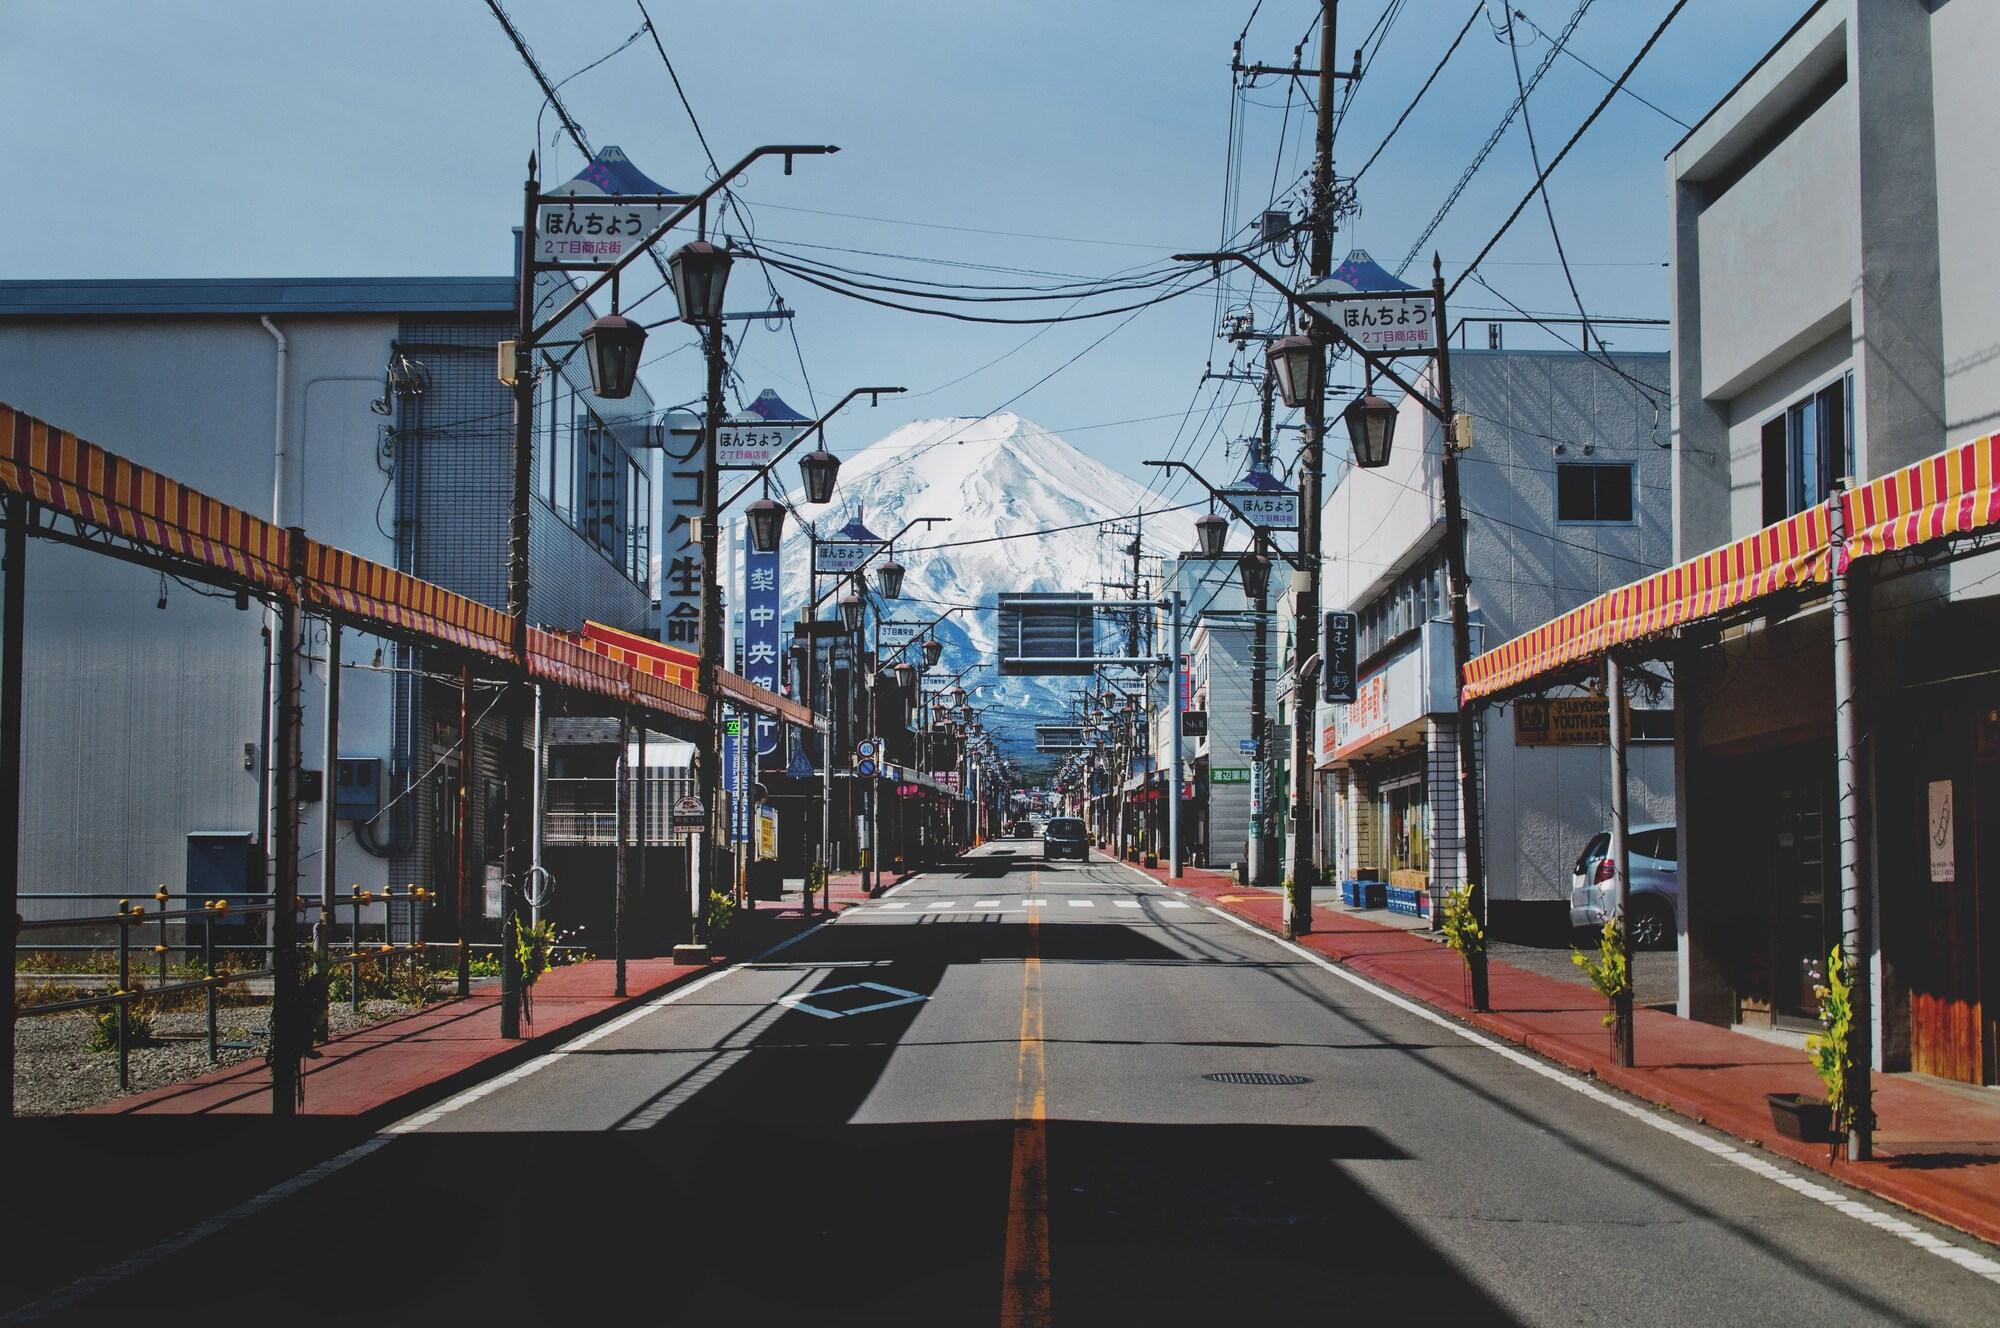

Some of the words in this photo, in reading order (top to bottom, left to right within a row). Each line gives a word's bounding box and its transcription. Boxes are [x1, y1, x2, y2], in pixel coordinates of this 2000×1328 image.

[545, 212, 642, 236] ほんちょう
[1343, 304, 1429, 328] ほんちょう
[720, 431, 783, 448] ほんちょう
[1243, 499, 1295, 514] ほんちょう
[665, 428, 706, 643] フコク生命
[819, 547, 865, 560] ほんちょう
[861, 745, 872, 754] 40
